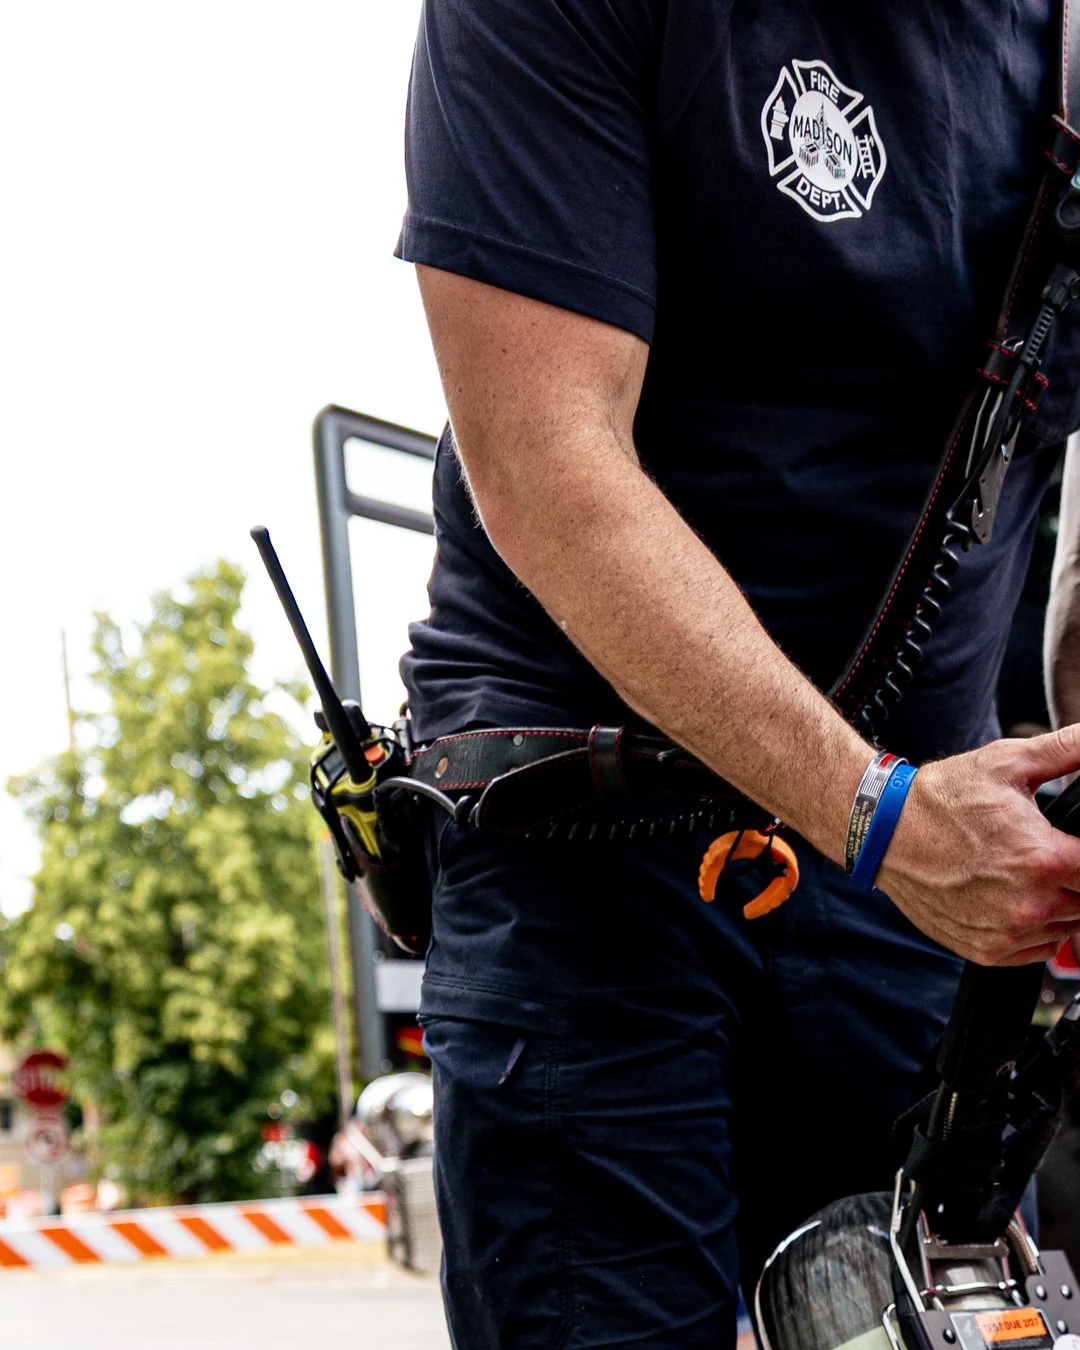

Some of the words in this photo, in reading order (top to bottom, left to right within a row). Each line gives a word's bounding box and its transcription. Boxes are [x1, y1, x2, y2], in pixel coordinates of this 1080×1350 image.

[810, 70, 840, 104] FIRE
[793, 115, 853, 166] MADISON
[795, 176, 847, 211] DEPT.
[1004, 1319, 1022, 1330] DUE
